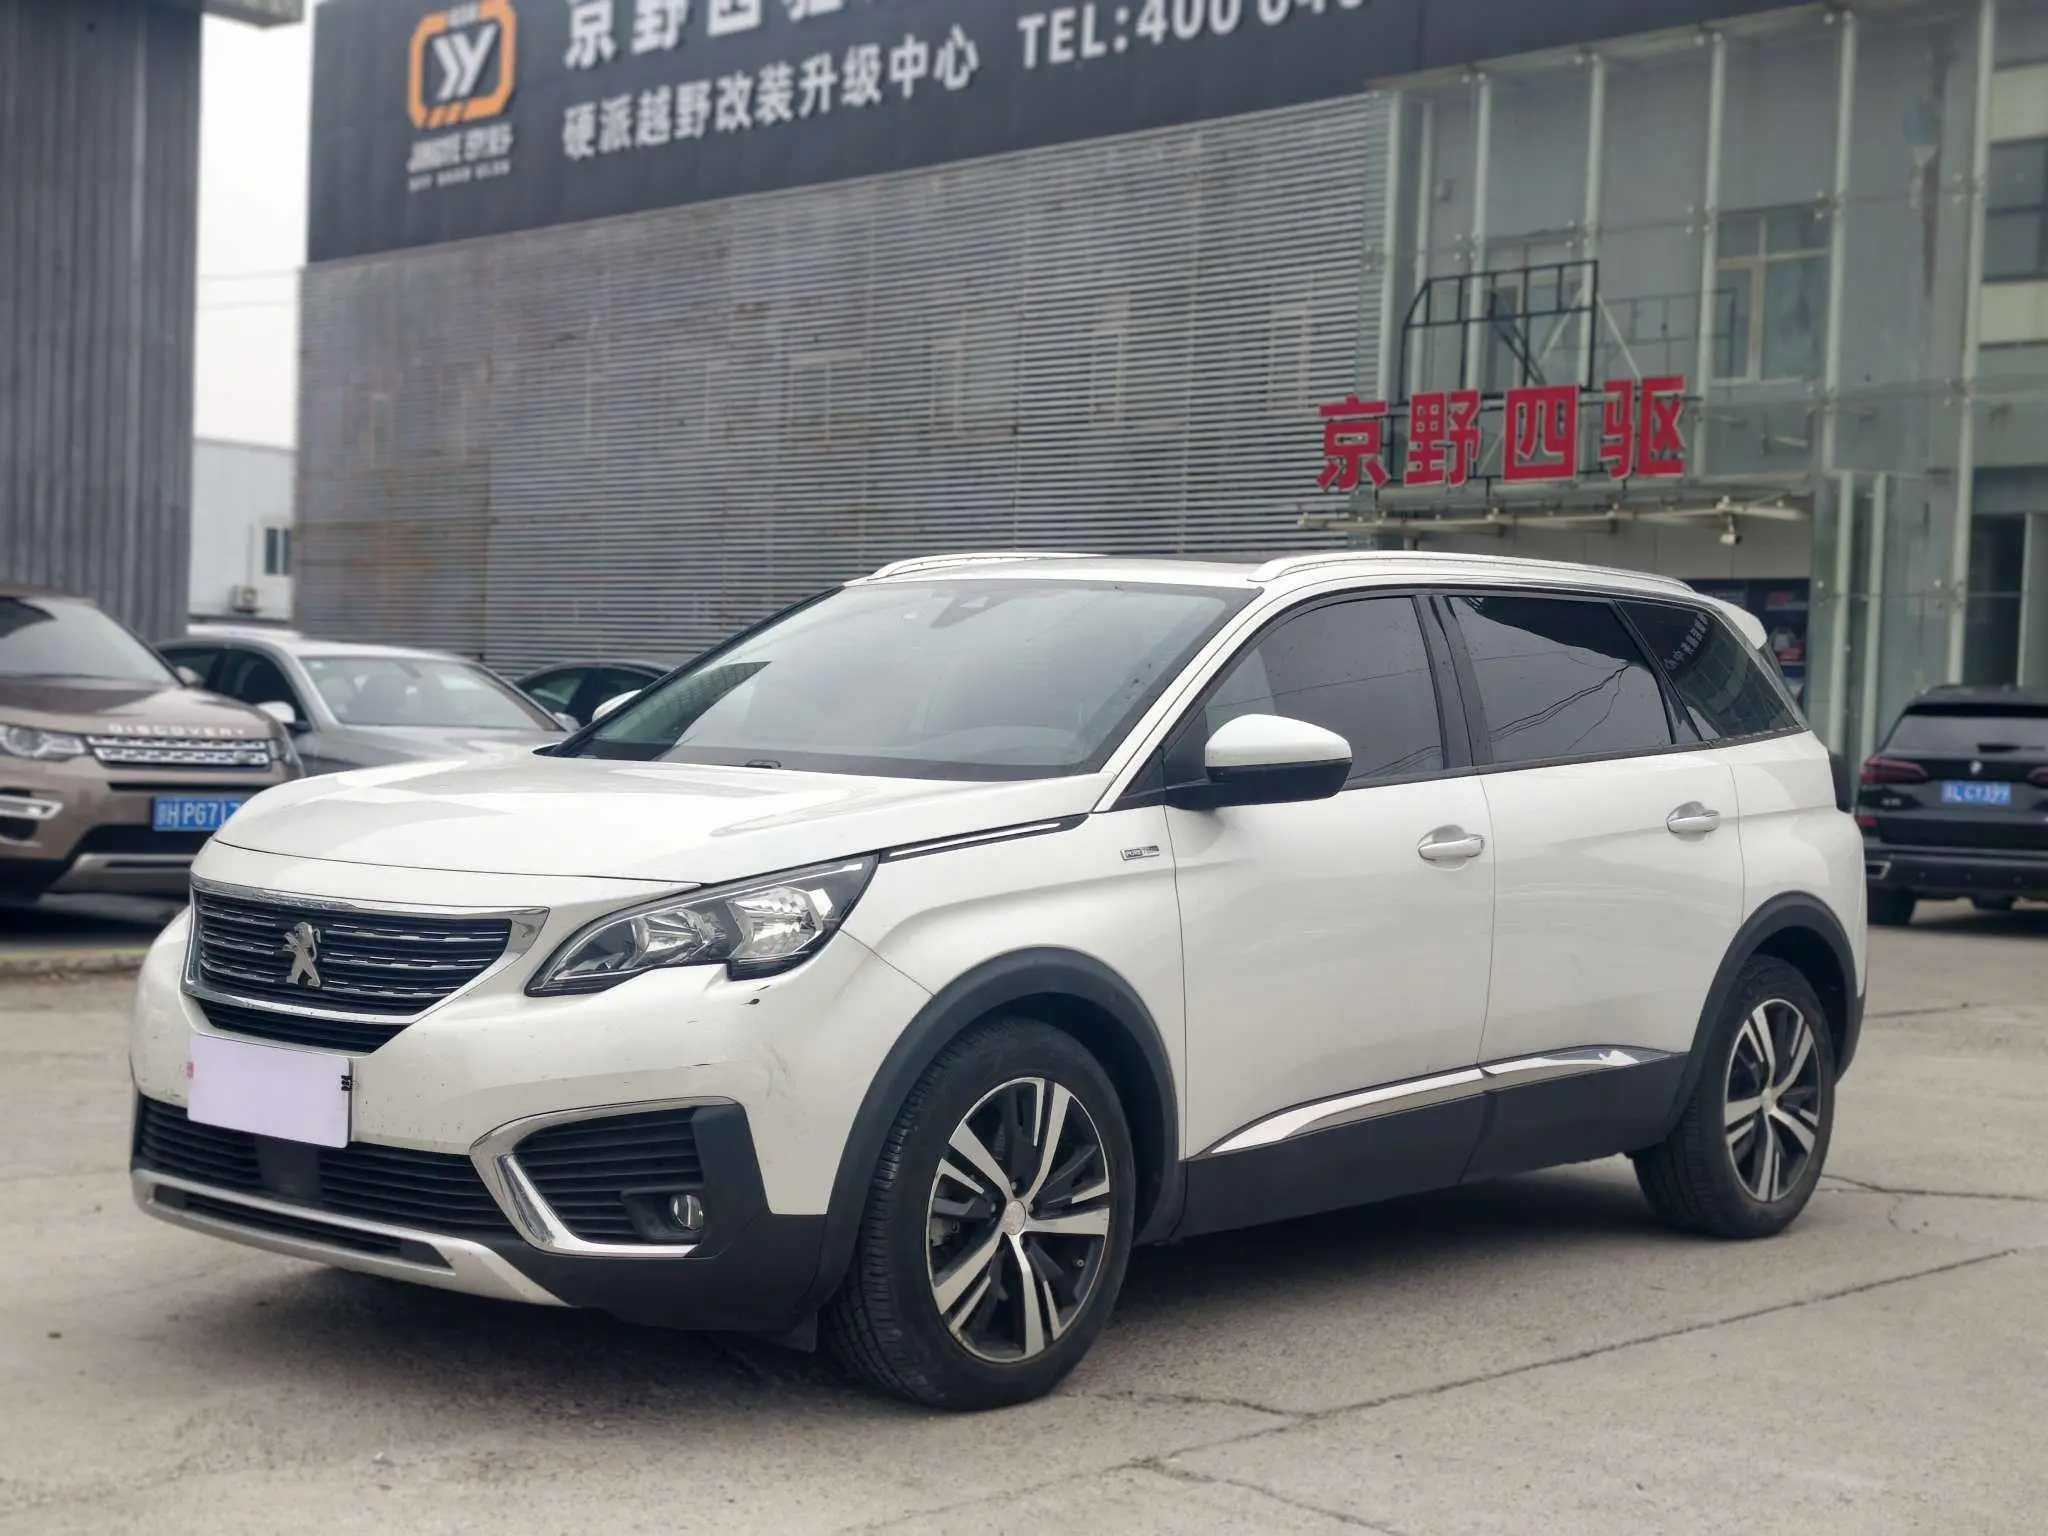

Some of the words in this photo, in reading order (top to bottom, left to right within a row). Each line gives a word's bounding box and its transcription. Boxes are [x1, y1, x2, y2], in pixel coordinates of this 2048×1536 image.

[562, 22, 979, 161] 硬派越野改装升级中心
[1316, 374, 1687, 493] 京野四驱
